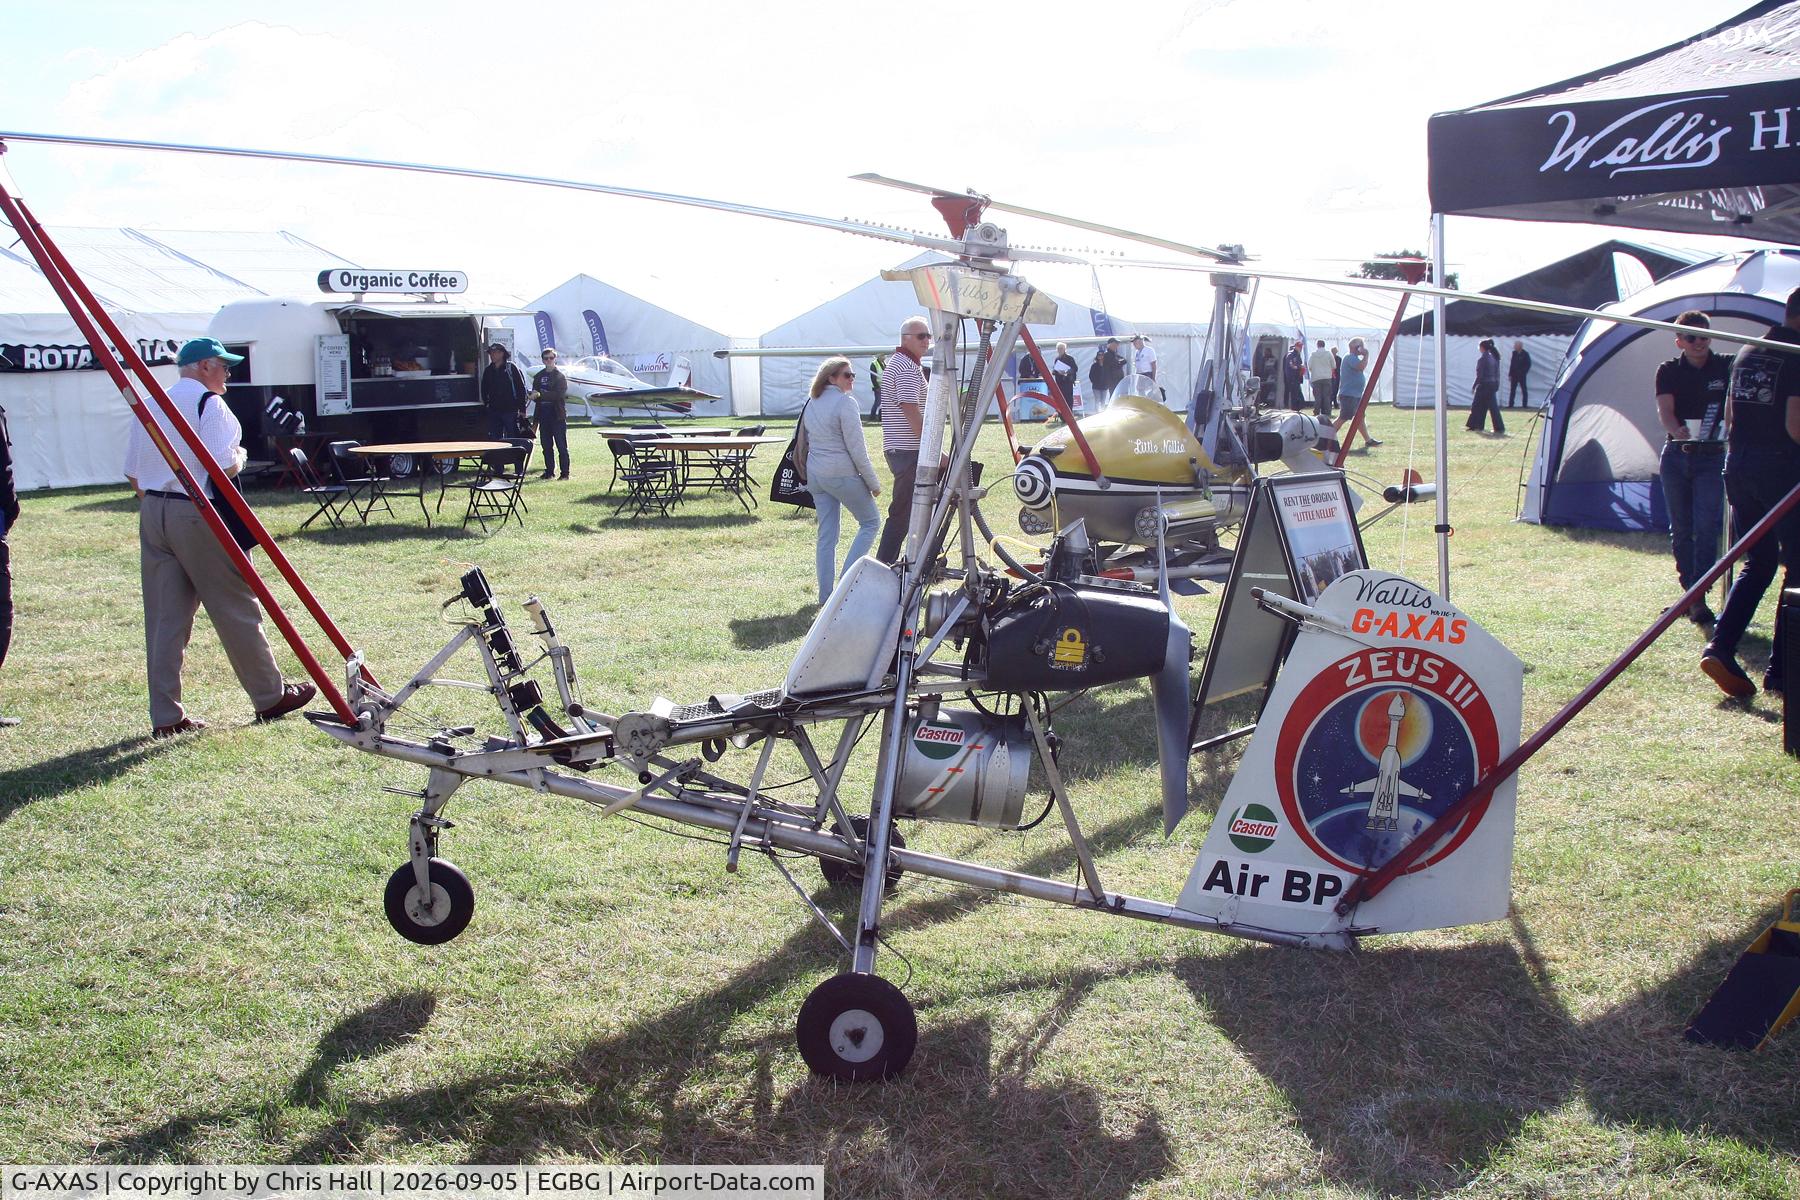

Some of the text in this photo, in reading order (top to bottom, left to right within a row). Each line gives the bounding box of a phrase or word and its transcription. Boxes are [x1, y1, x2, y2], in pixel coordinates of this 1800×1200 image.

[1539, 95, 1800, 179] Wallis H
[340, 271, 458, 290] Organic Coffee
[782, 469, 793, 479] 80
[1283, 491, 1339, 507] RENT THE ORIGINAL
[1340, 574, 1432, 609] Wallis
[1351, 608, 1469, 645] G-AXAS
[1338, 651, 1480, 709] ZEUS III
[917, 727, 964, 743] Castrol
[1231, 819, 1279, 838] Castrol
[1202, 859, 1343, 906] Air BP
